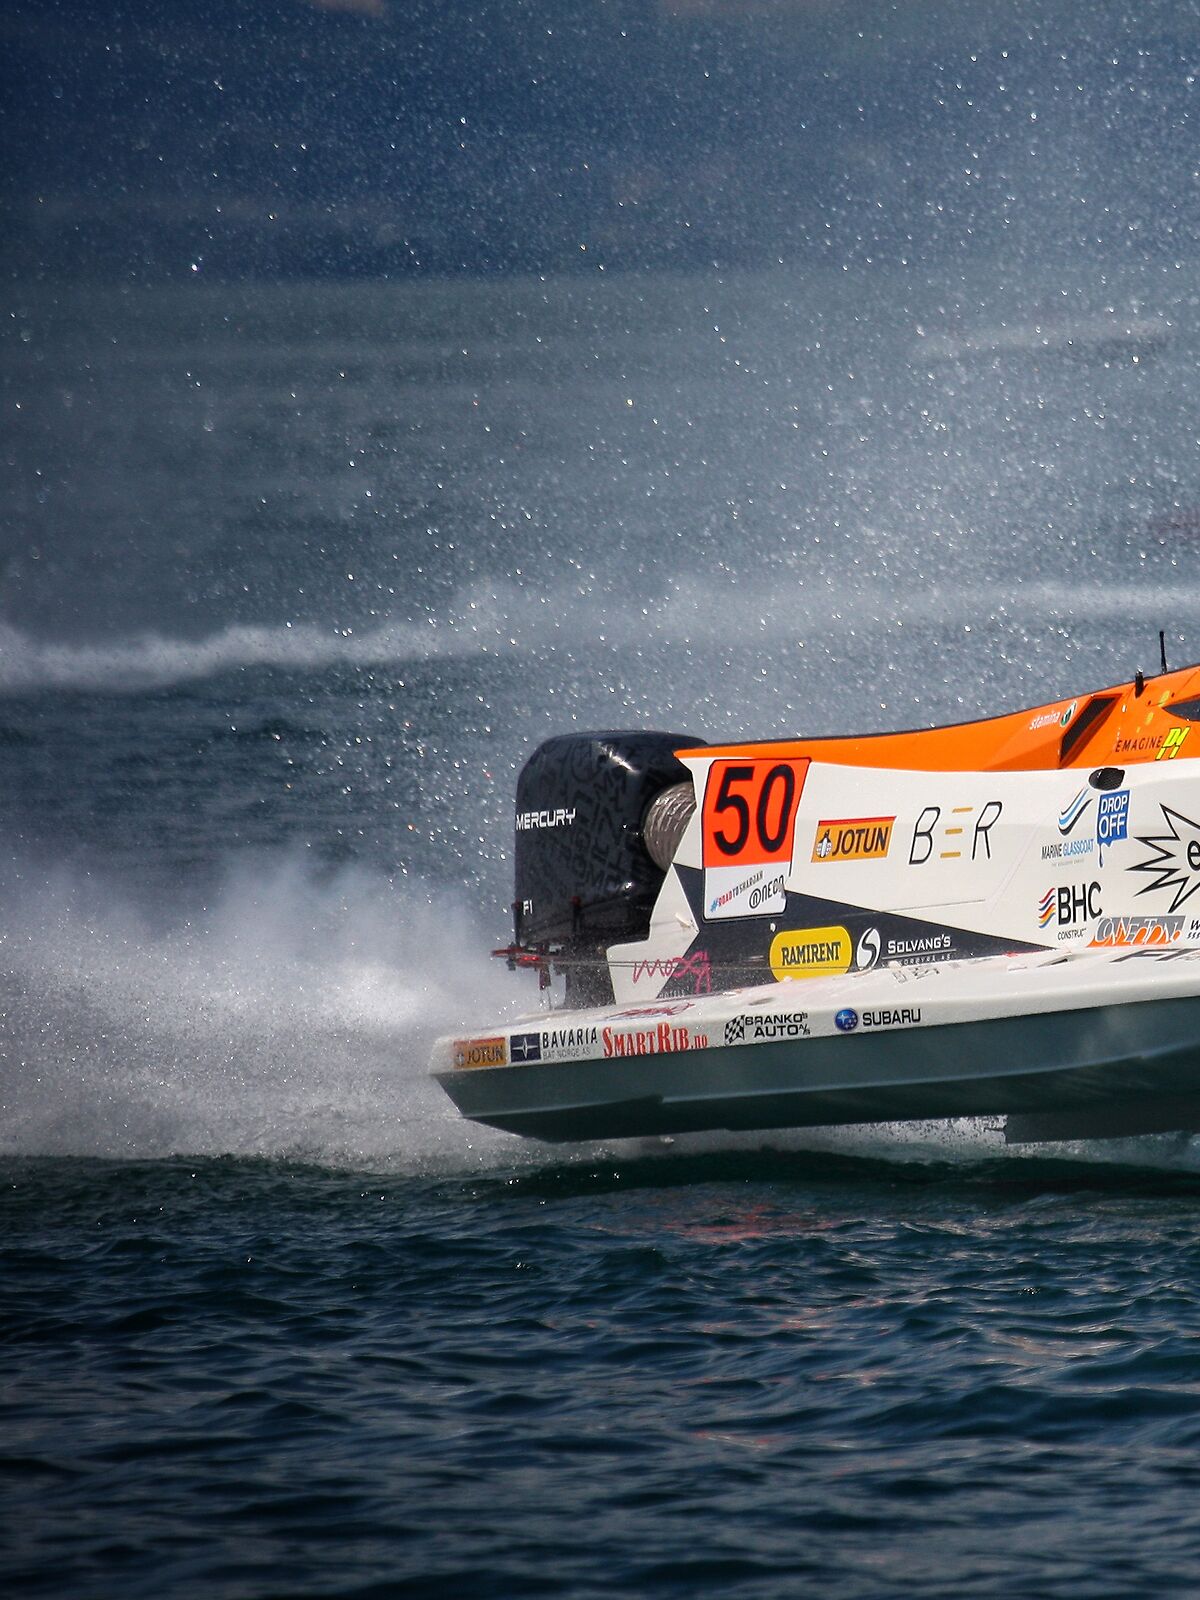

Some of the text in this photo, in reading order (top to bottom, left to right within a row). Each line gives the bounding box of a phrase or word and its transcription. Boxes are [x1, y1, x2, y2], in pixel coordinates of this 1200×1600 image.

[1115, 735, 1163, 752] EMAGINE
[713, 764, 795, 856] 50
[1101, 795, 1128, 814] DROP
[516, 808, 576, 830] MERCURY
[1099, 813, 1126, 838] OFF
[832, 827, 889, 856] JOTUN
[1042, 844, 1062, 860] MARINE
[522, 900, 533, 916] F1
[1058, 881, 1102, 926] BHC
[781, 942, 842, 966] RAMIRENT
[862, 1008, 921, 1026] SUBARU
[542, 1027, 598, 1048] BAVARIA
[467, 1046, 504, 1064] JOTUN
